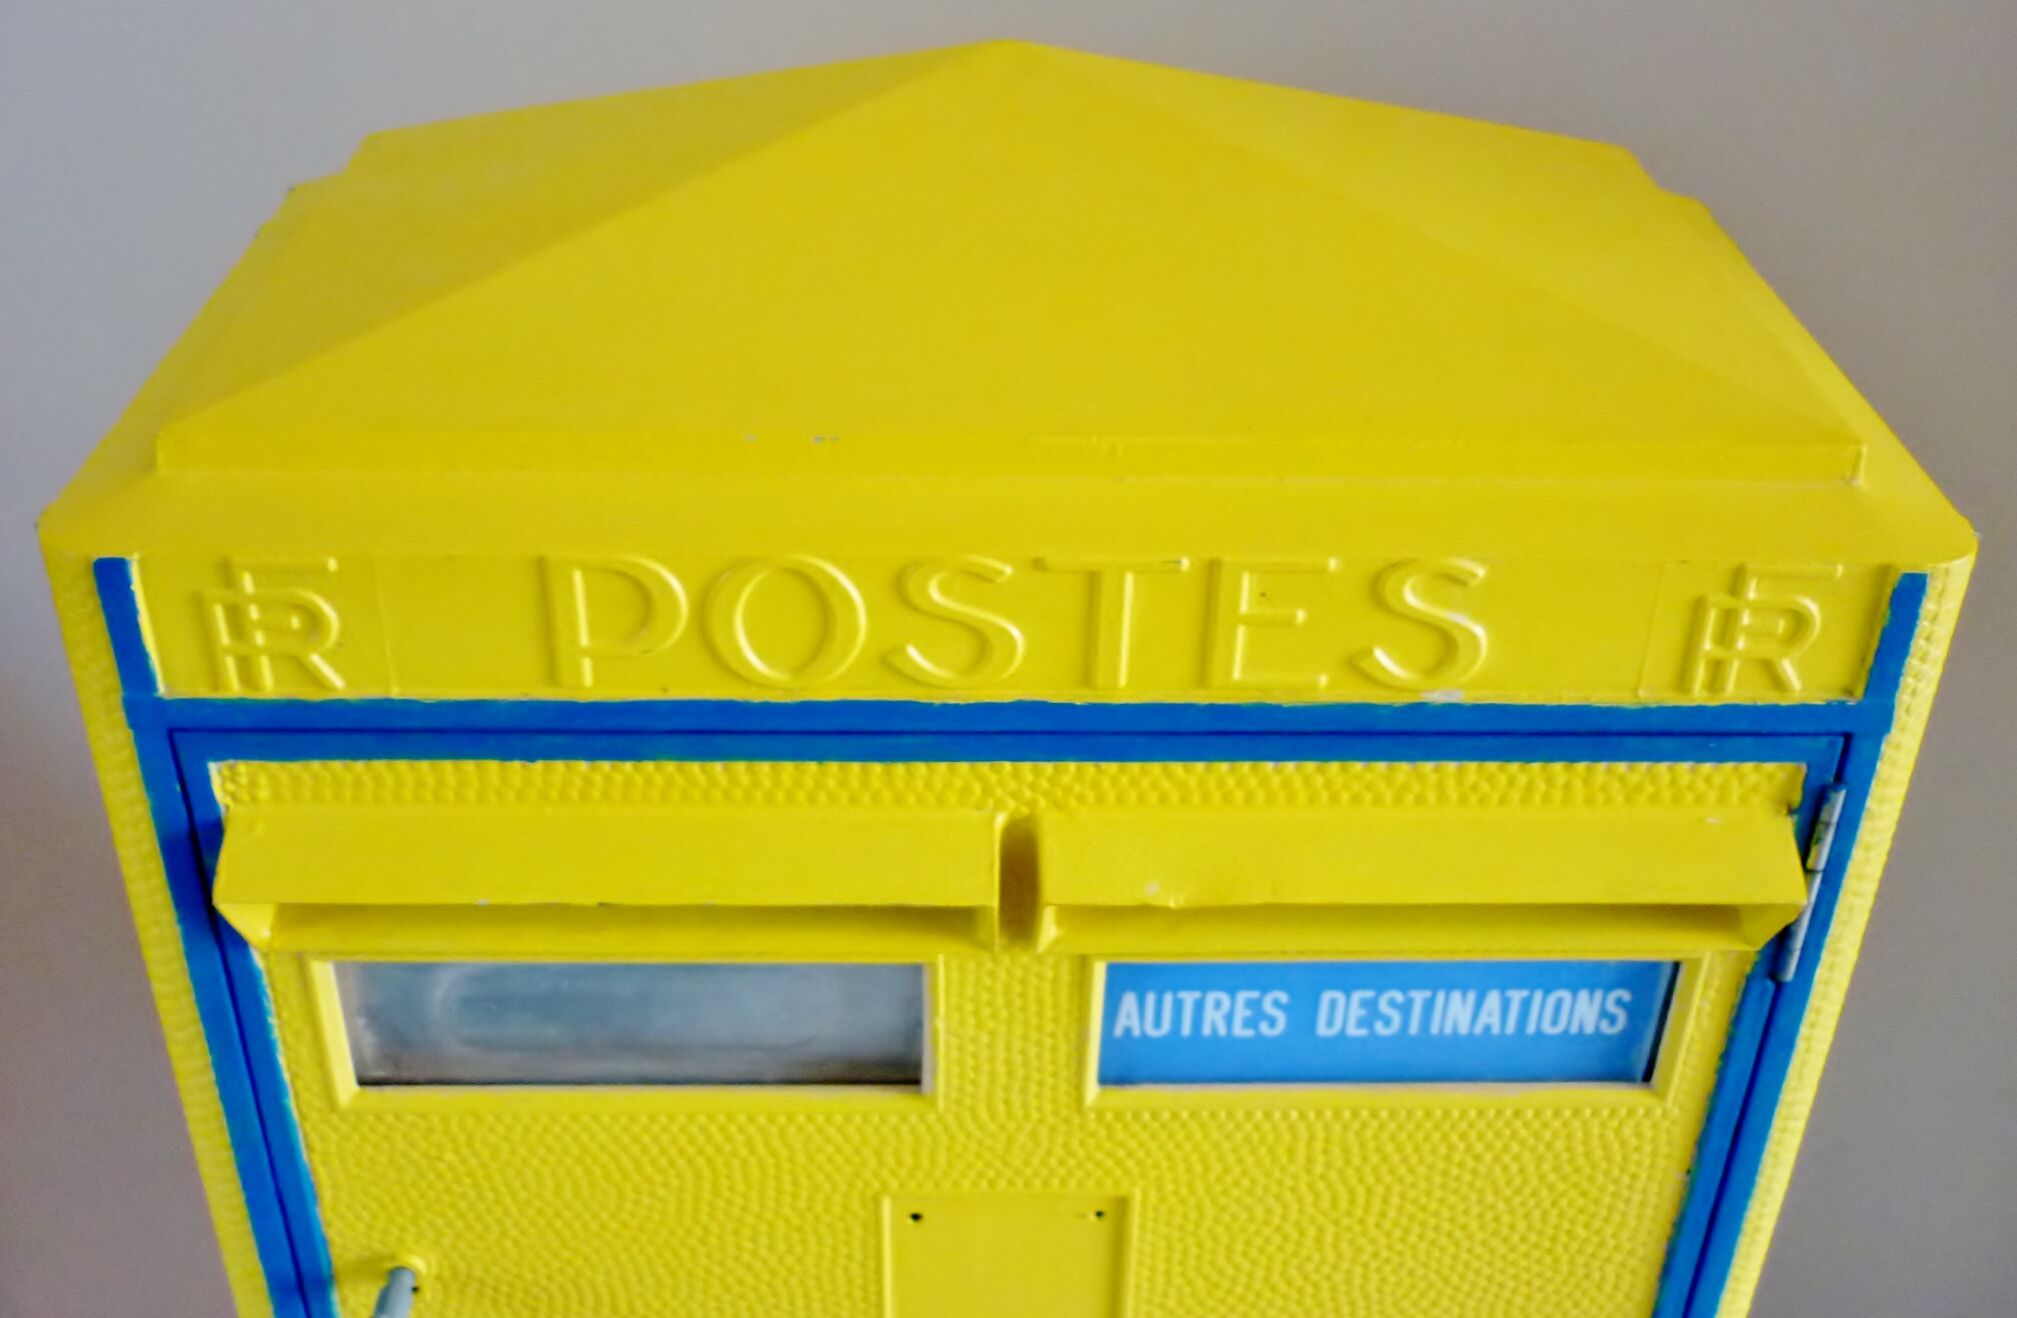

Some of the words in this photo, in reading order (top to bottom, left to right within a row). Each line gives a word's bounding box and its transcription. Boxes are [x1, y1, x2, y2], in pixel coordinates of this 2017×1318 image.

[535, 553, 1491, 692] POSTES
[1112, 989, 1290, 1039] AUTRES
[1315, 987, 1634, 1038] DESTINATIONS
